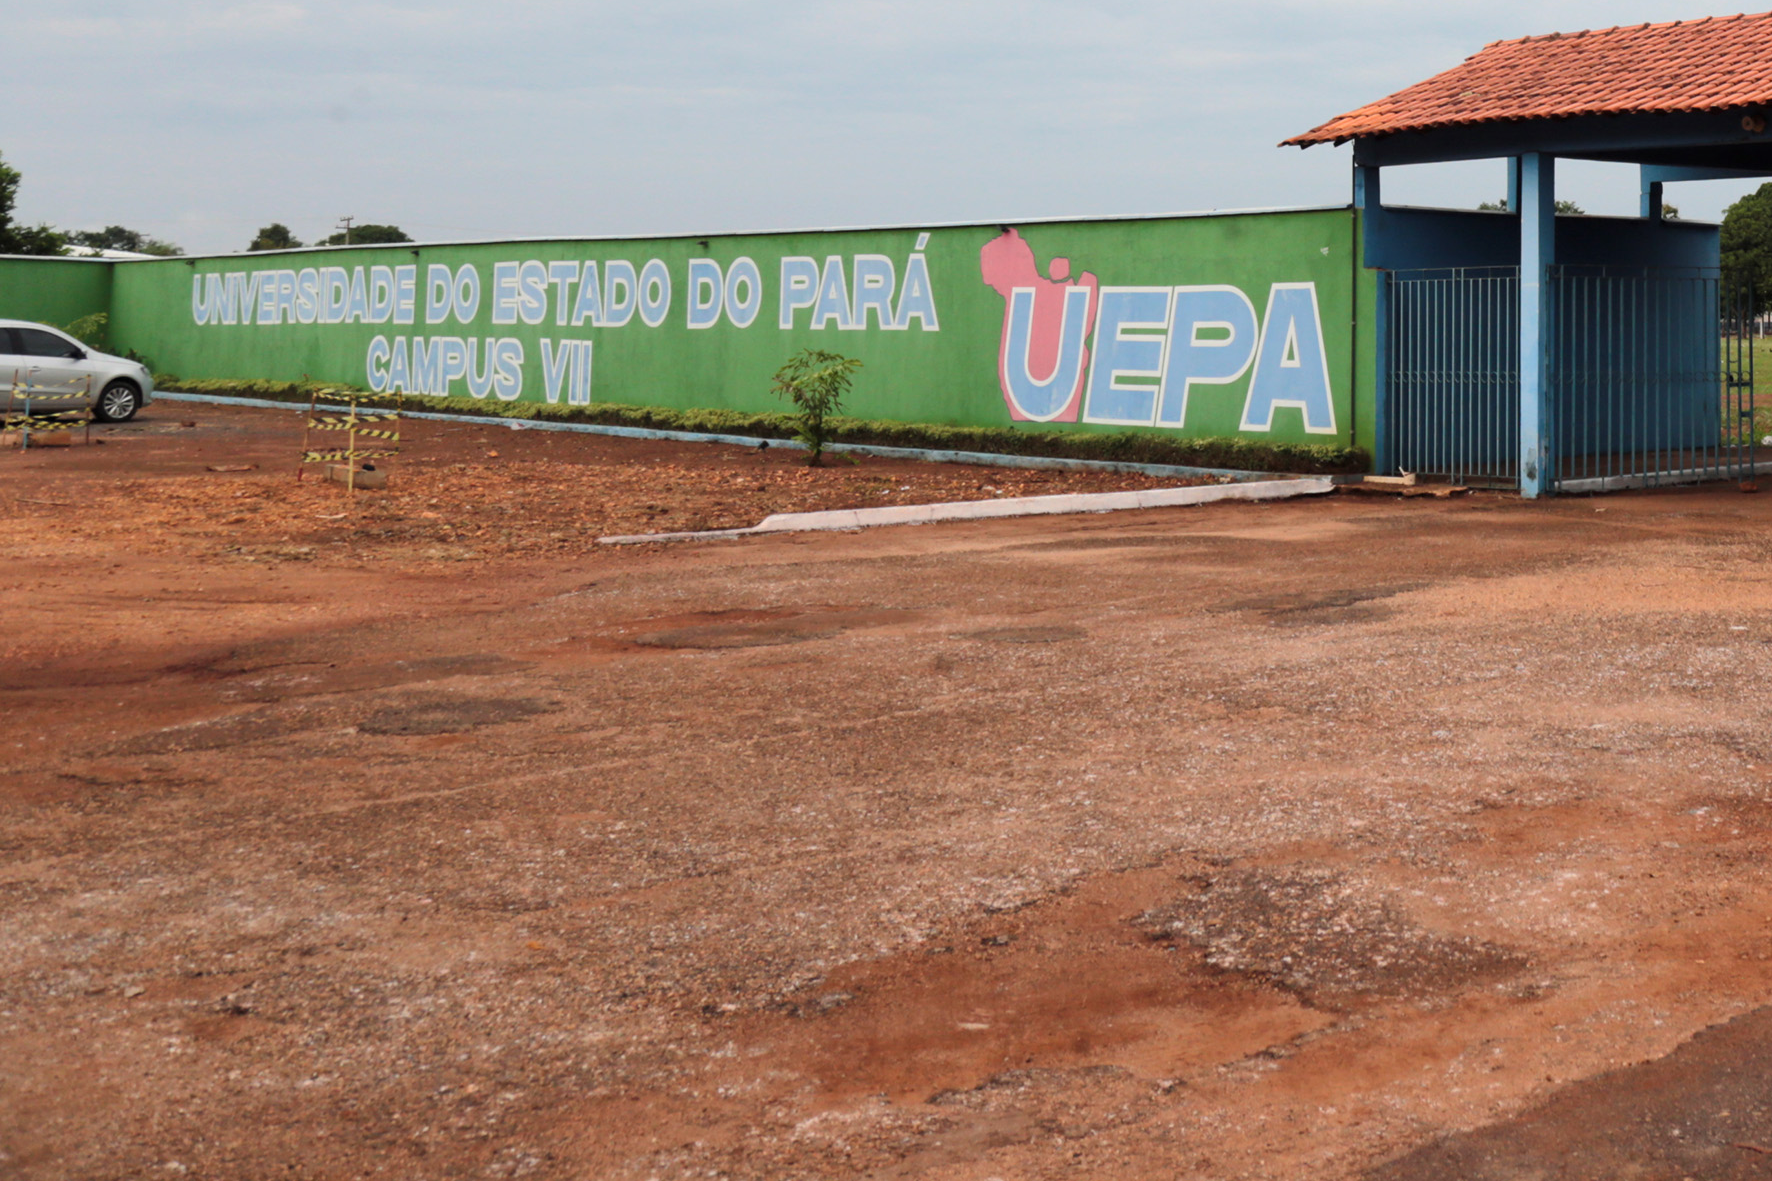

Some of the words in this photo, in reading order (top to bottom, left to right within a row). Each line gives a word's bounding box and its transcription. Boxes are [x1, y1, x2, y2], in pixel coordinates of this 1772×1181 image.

[192, 264, 417, 326] UNIVERSIDADE
[426, 263, 481, 325] DO
[492, 258, 672, 328] ESTADO
[686, 256, 763, 330] DO
[778, 232, 940, 332] PARÁ
[366, 334, 524, 401] CAMPUS
[539, 337, 593, 405] VII
[1003, 281, 1336, 435] UEPA
